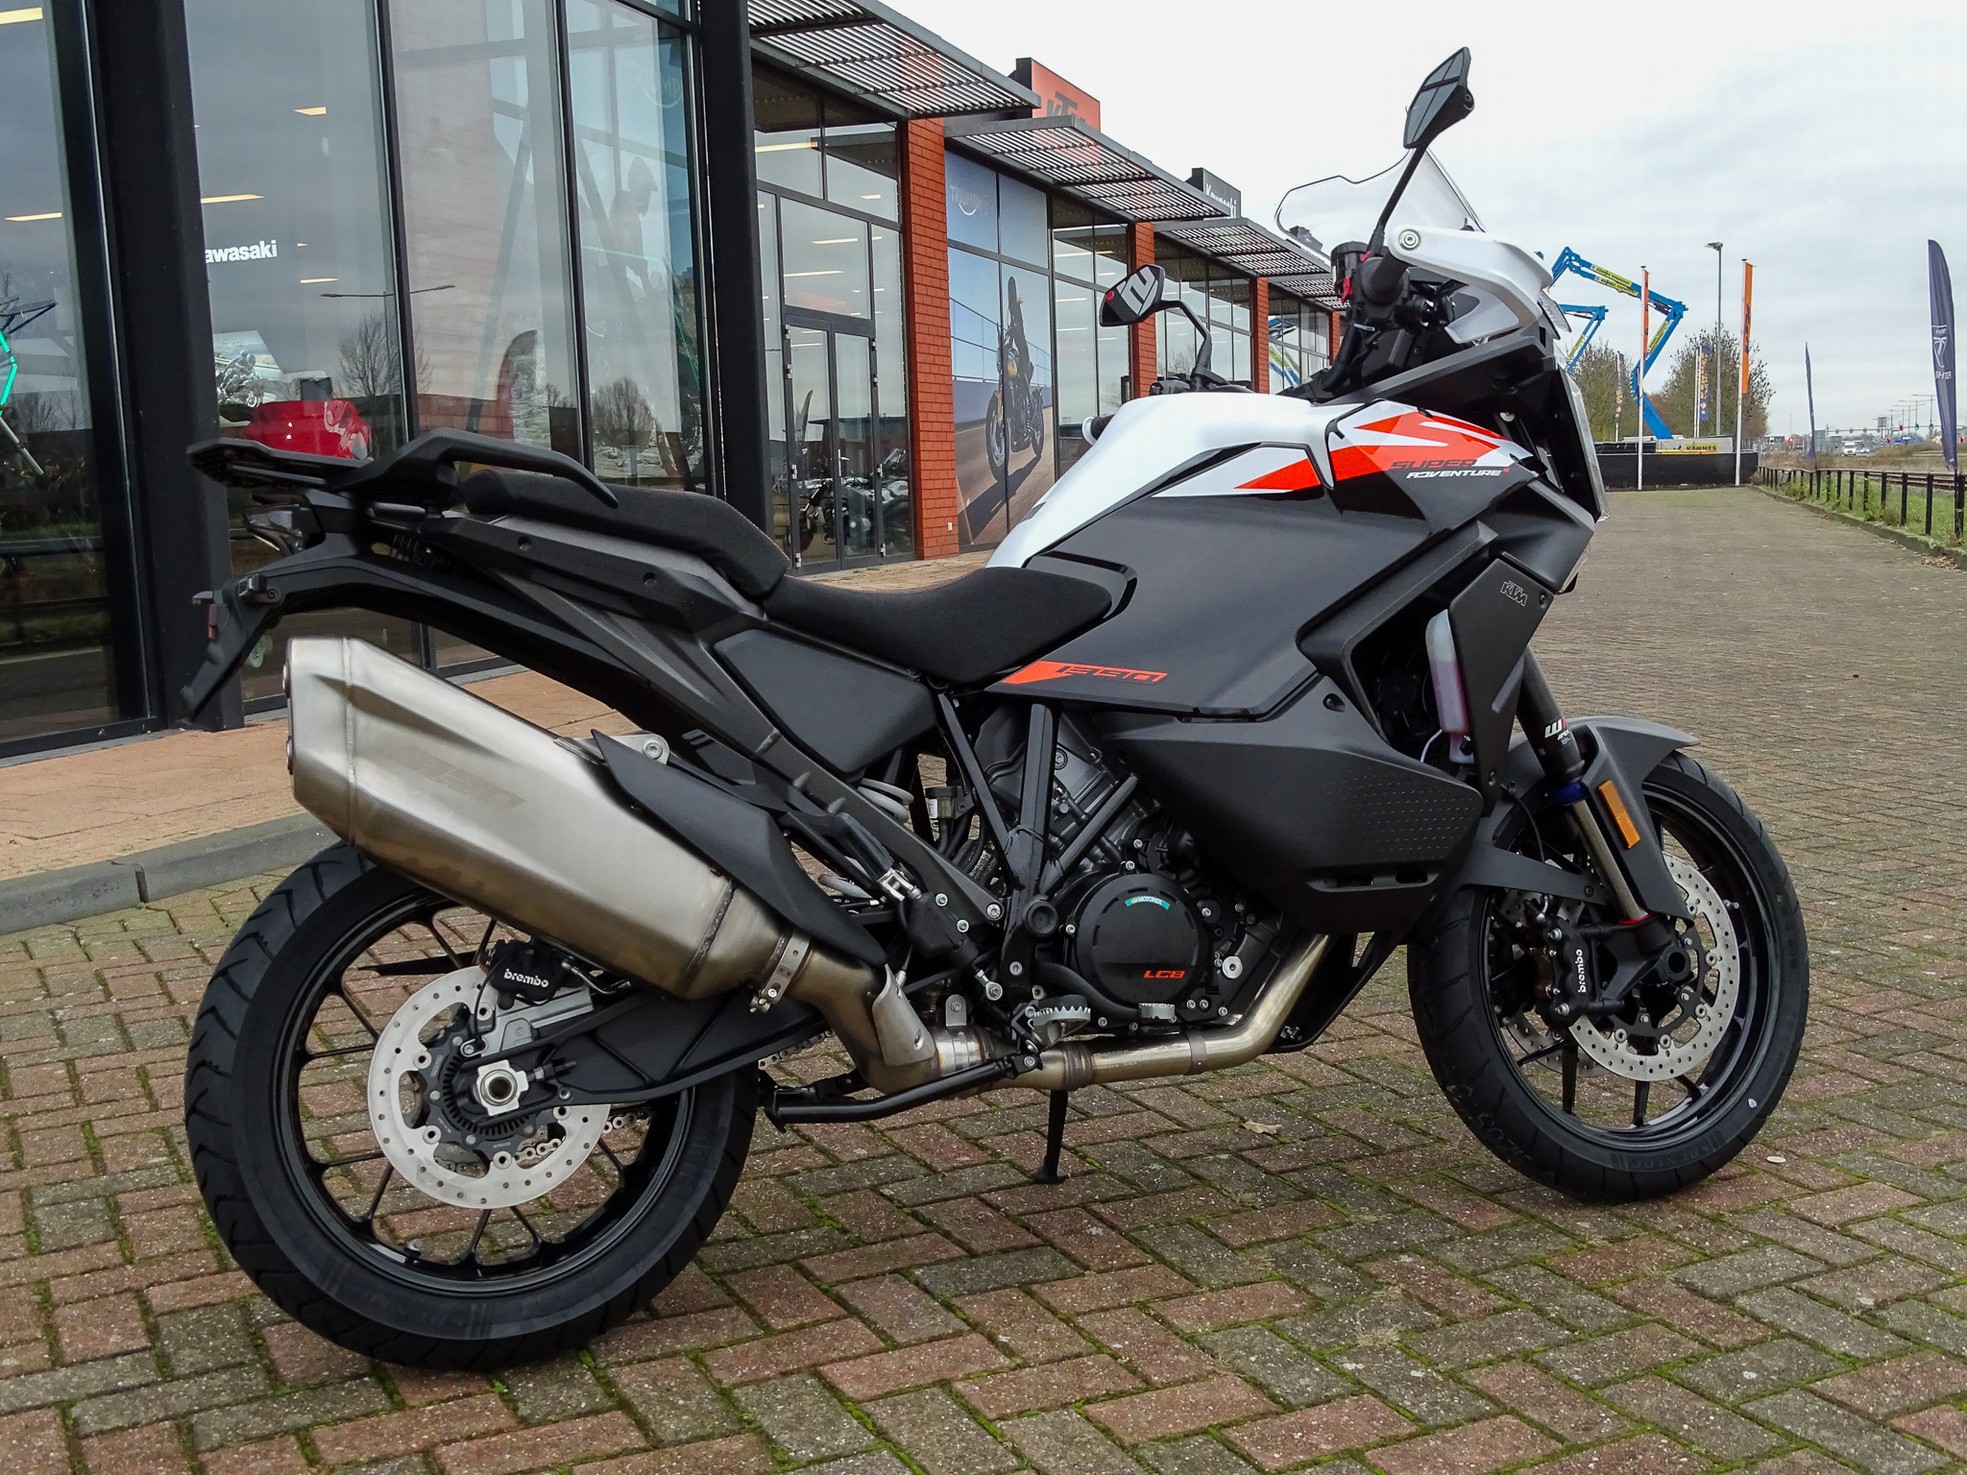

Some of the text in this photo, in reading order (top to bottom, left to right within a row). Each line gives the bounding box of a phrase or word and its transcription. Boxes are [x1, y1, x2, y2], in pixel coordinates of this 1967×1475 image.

[205, 240, 278, 263] awasaki
[1390, 458, 1479, 469] SUPER
[1405, 468, 1503, 479] ADVENTURE
[1500, 580, 1528, 607] KTM
[503, 968, 549, 988] brembo
[1143, 970, 1186, 979] LC8
[1574, 949, 1587, 993] brembo
